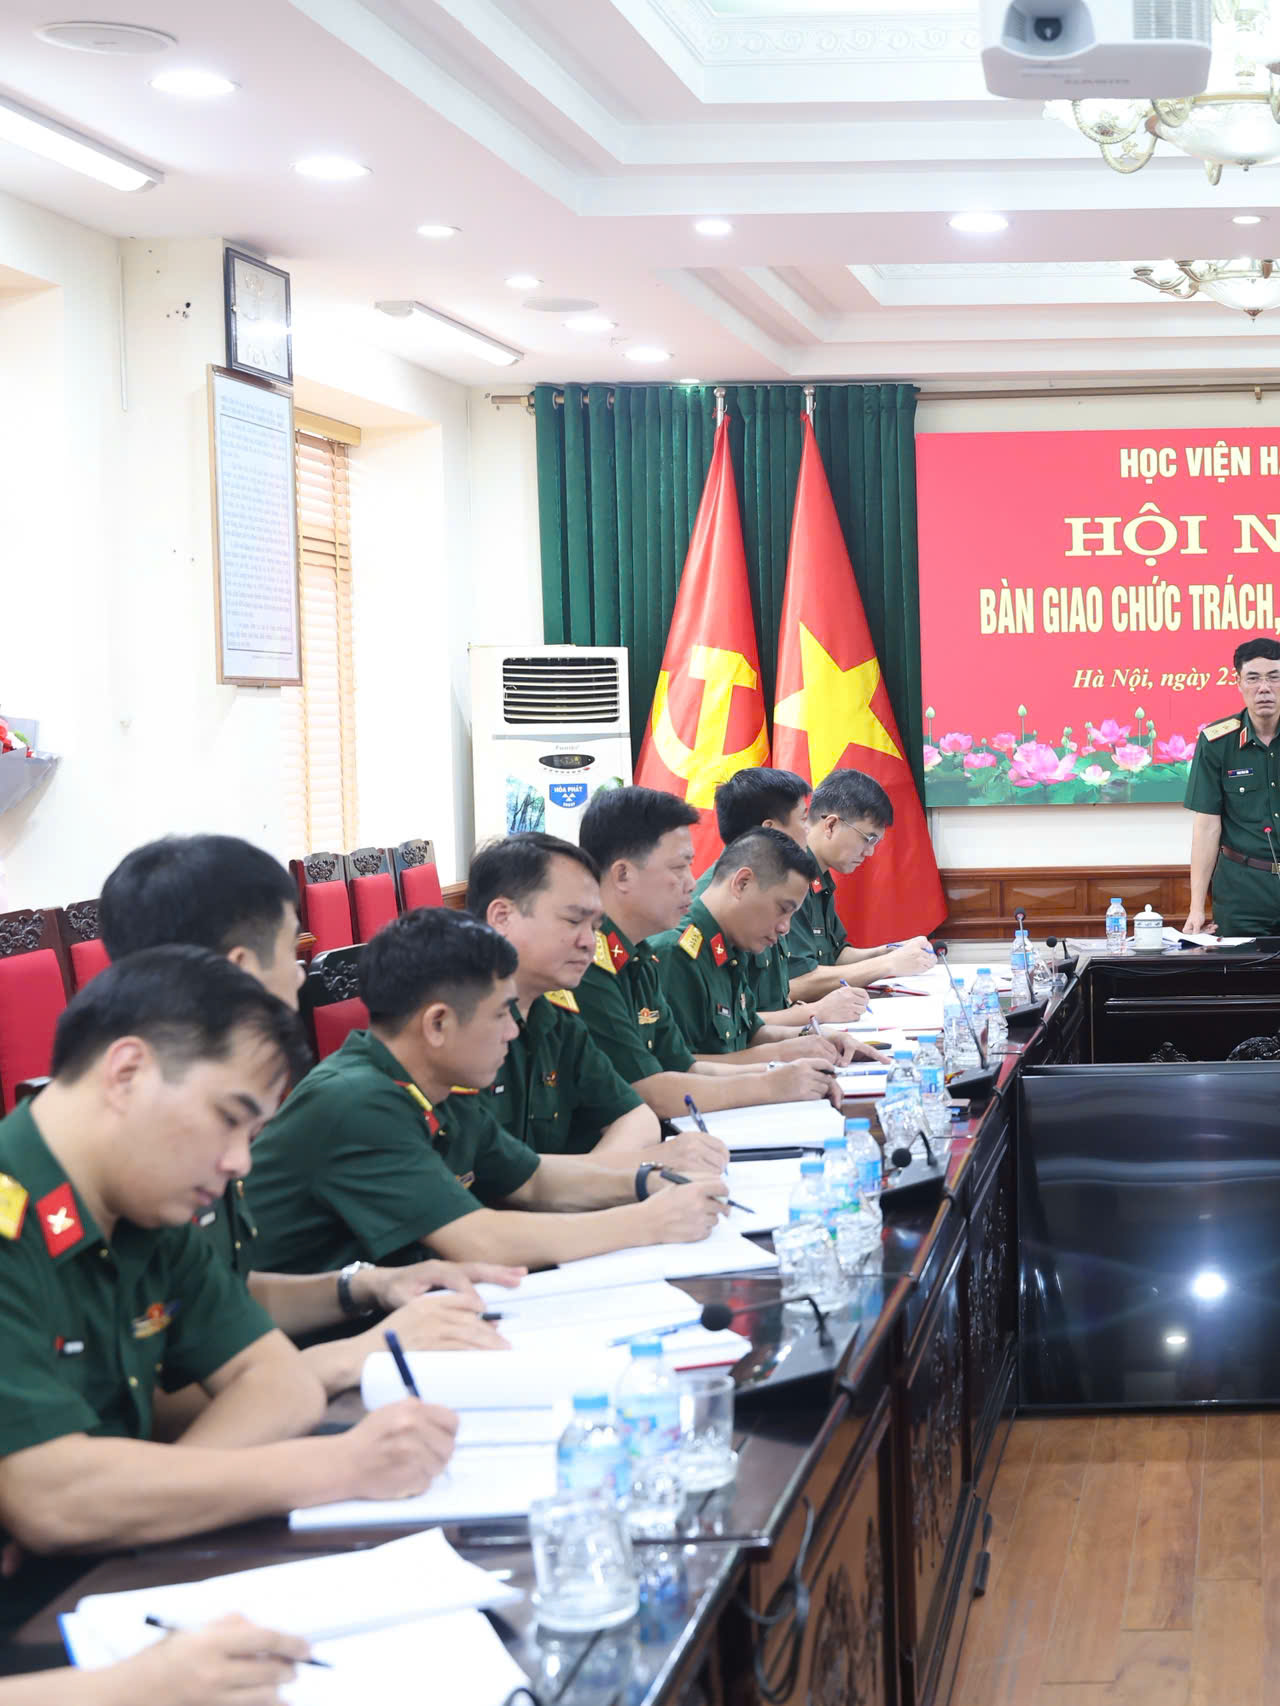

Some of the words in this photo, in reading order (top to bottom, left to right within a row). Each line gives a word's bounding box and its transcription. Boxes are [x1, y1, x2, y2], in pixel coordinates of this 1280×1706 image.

[1119, 447, 1178, 485] HỌC
[1184, 440, 1251, 484] VIỆN
[1063, 502, 1209, 567] HỘI
[979, 576, 1035, 635] BÀN
[1042, 585, 1104, 633] GIAO
[1111, 575, 1182, 633] CHỨC
[1072, 668, 1105, 689] Hà
[1110, 667, 1154, 694] Nội,
[1160, 666, 1211, 692] ngày
[1215, 666, 1239, 686] 23
